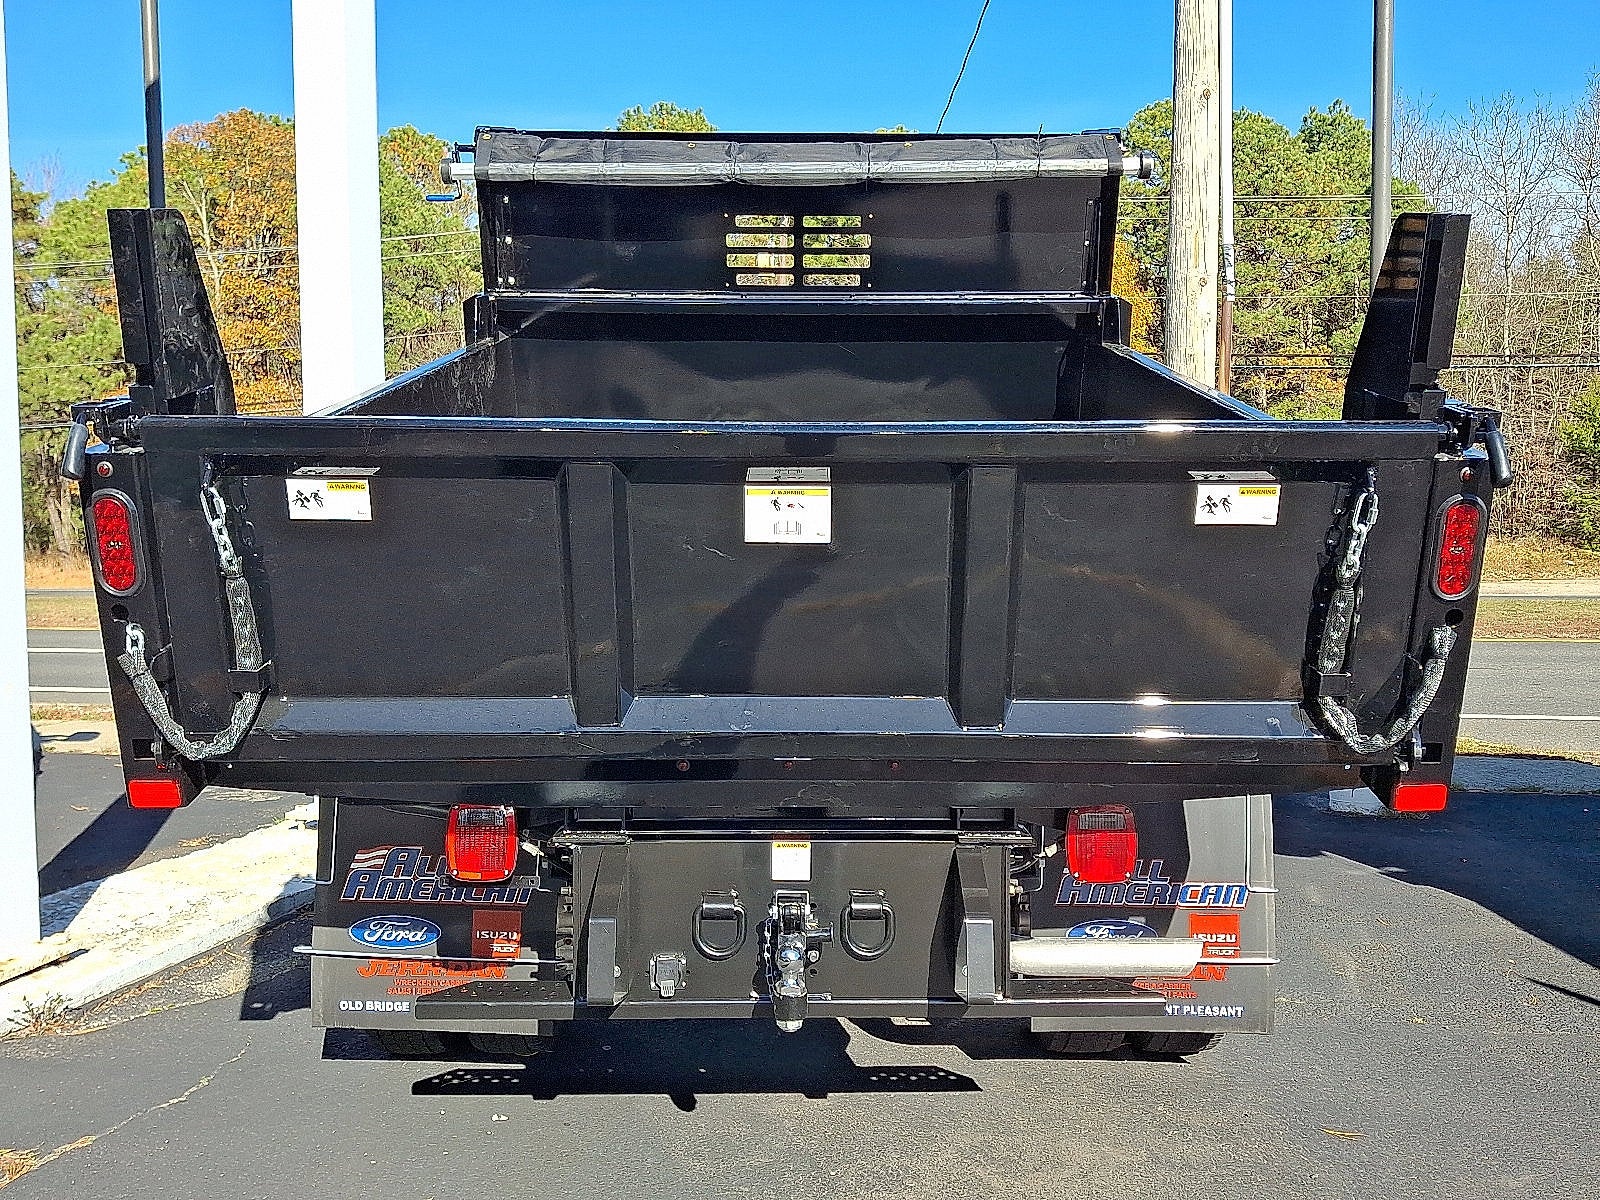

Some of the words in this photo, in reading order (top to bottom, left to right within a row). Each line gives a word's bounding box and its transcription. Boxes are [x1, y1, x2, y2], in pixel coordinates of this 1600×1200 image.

[340, 868, 533, 905] AMERICAN
[1056, 873, 1249, 908] AMERICAN
[364, 920, 428, 943] Ford
[476, 930, 518, 940] ISUZU
[1191, 933, 1237, 943] ISUZU
[393, 979, 431, 987] WRECKER
[339, 1000, 364, 1011] OLD
[365, 1000, 410, 1013] BRIDGE
[1183, 1004, 1244, 1018] PLEASANT
